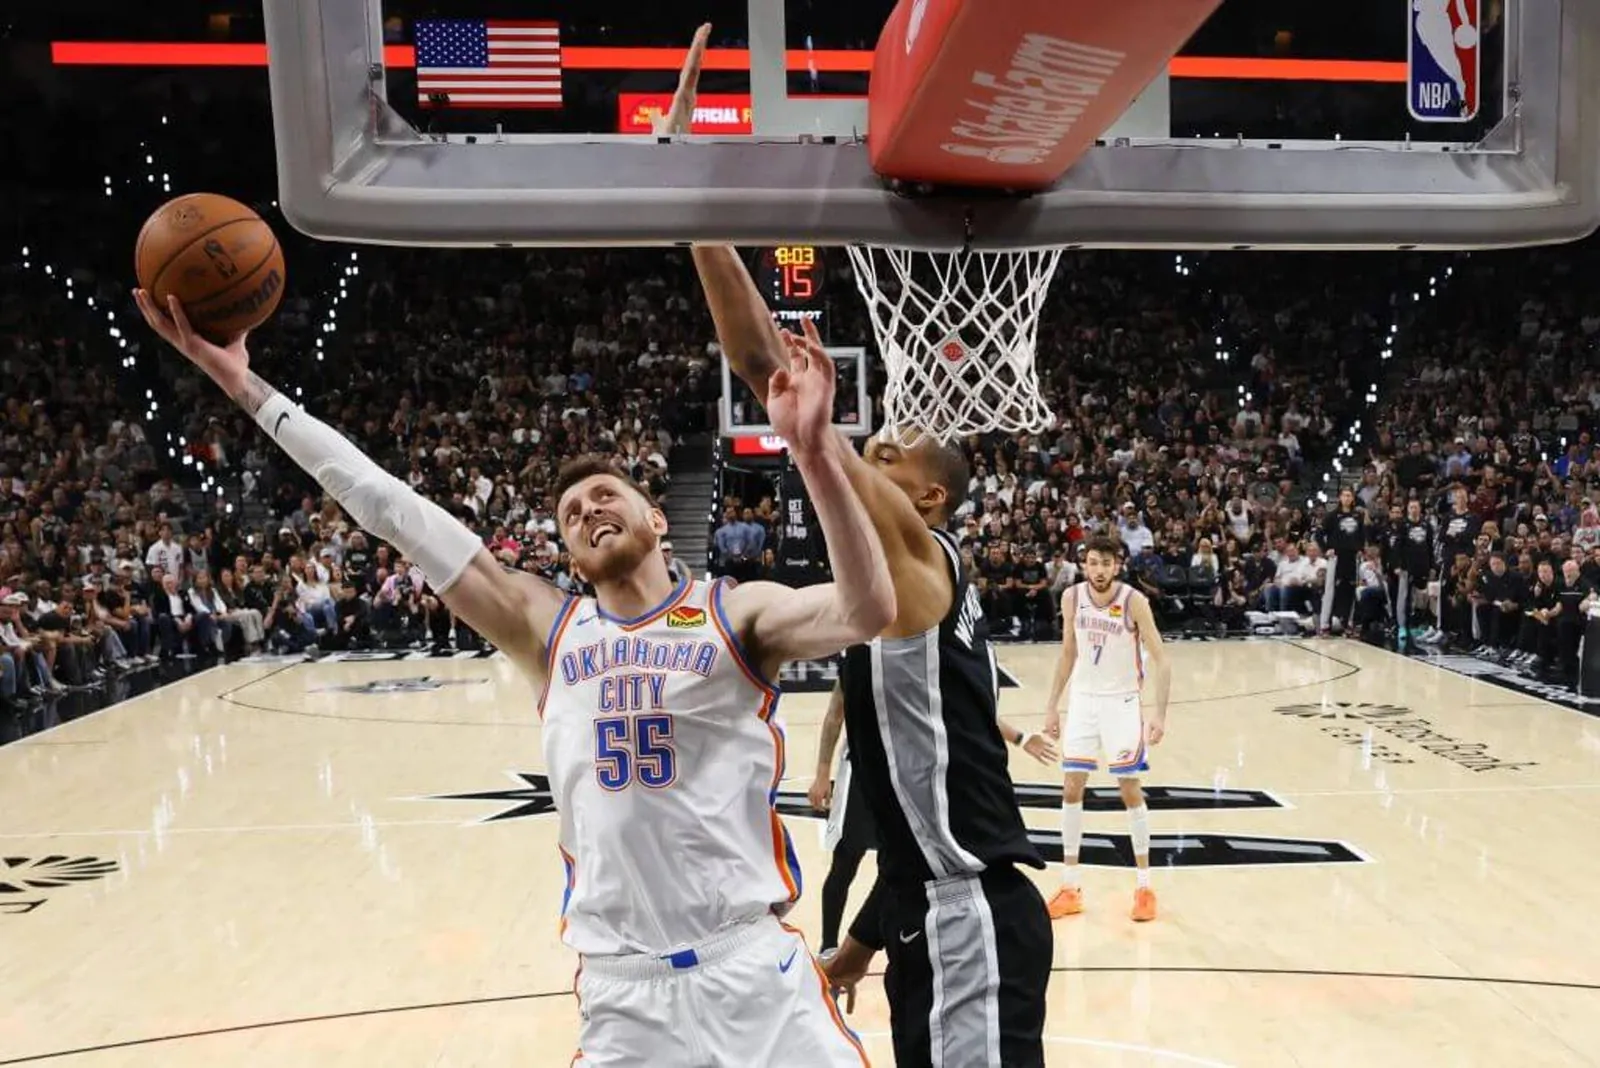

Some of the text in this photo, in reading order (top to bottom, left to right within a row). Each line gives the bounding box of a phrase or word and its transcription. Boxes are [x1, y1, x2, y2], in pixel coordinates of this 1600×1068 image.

[1419, 82, 1451, 109] NBA
[690, 107, 740, 124] FFICIAL
[777, 247, 814, 265] 8:03
[784, 264, 812, 297] 15
[560, 636, 719, 686] OKLAHOMA
[1093, 645, 1103, 665] 7
[599, 672, 667, 713] CITY
[593, 714, 677, 792] 55
